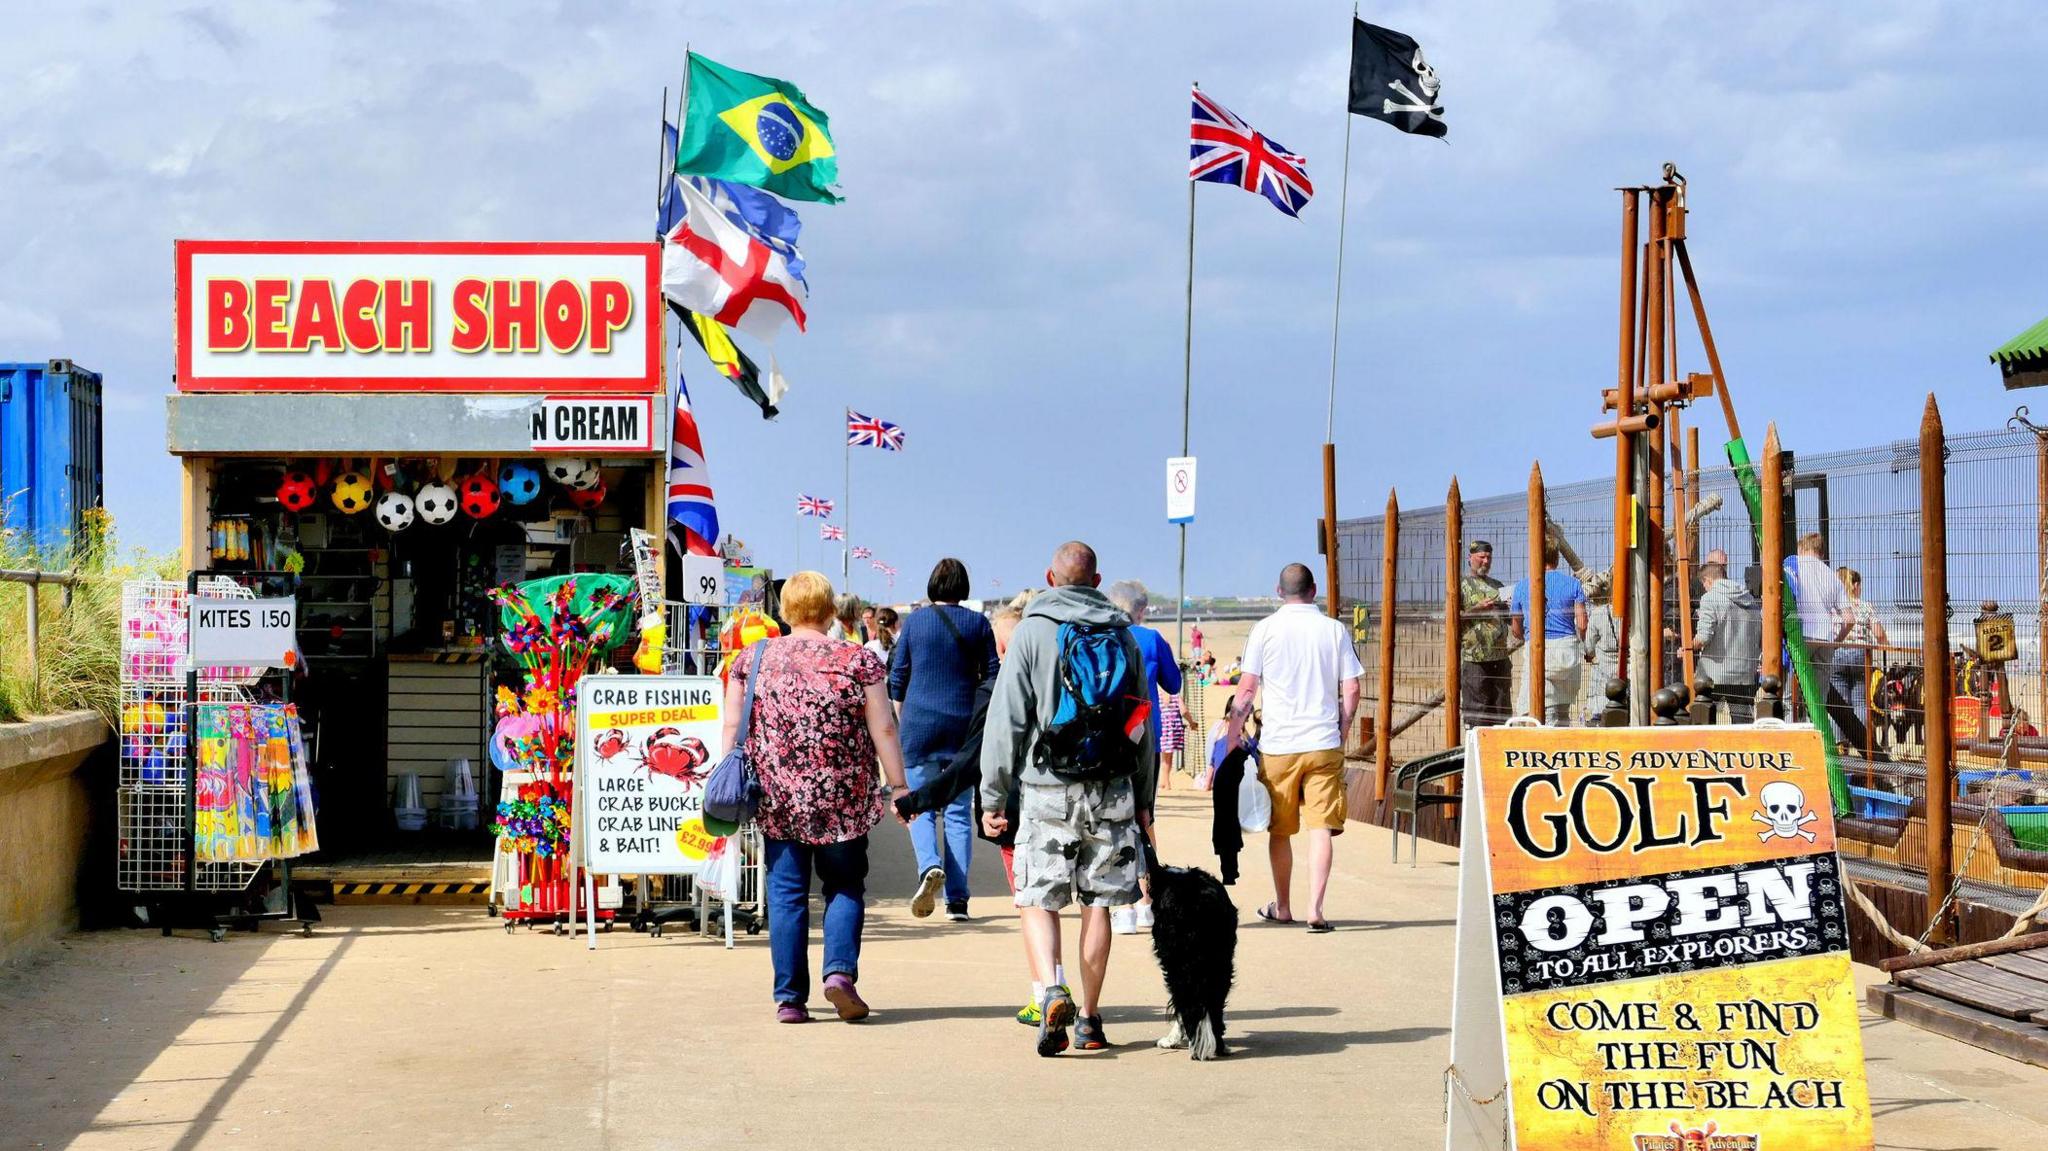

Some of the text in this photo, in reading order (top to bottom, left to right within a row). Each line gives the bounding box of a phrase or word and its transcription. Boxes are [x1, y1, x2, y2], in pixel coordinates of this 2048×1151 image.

[206, 276, 632, 352] BEACH SHOP
[555, 406, 638, 441] CREAM
[700, 576, 717, 595] 99
[200, 609, 291, 628] KITES 1.50
[1983, 625, 2009, 635] HOLE
[1989, 635, 2004, 651] 2
[593, 688, 712, 706] CRAB FISHING
[610, 709, 697, 726] SUPER DEAL
[1505, 749, 1801, 771] PIRATES ADVENTURE
[598, 778, 644, 792] LARGE
[598, 797, 701, 811] CRAB BUCKE
[598, 816, 682, 832] CRAB LINE
[1507, 772, 1748, 859] GOLF
[600, 837, 660, 853] & BAIT!
[1517, 862, 1816, 952] OPEN
[1536, 926, 1810, 980] TO ALL EXPLORERS
[1546, 999, 1820, 1036] COME & FIND
[1598, 1038, 1785, 1075] THE FUN
[1536, 1079, 1598, 1116] ON
[1604, 1081, 1696, 1110] THE
